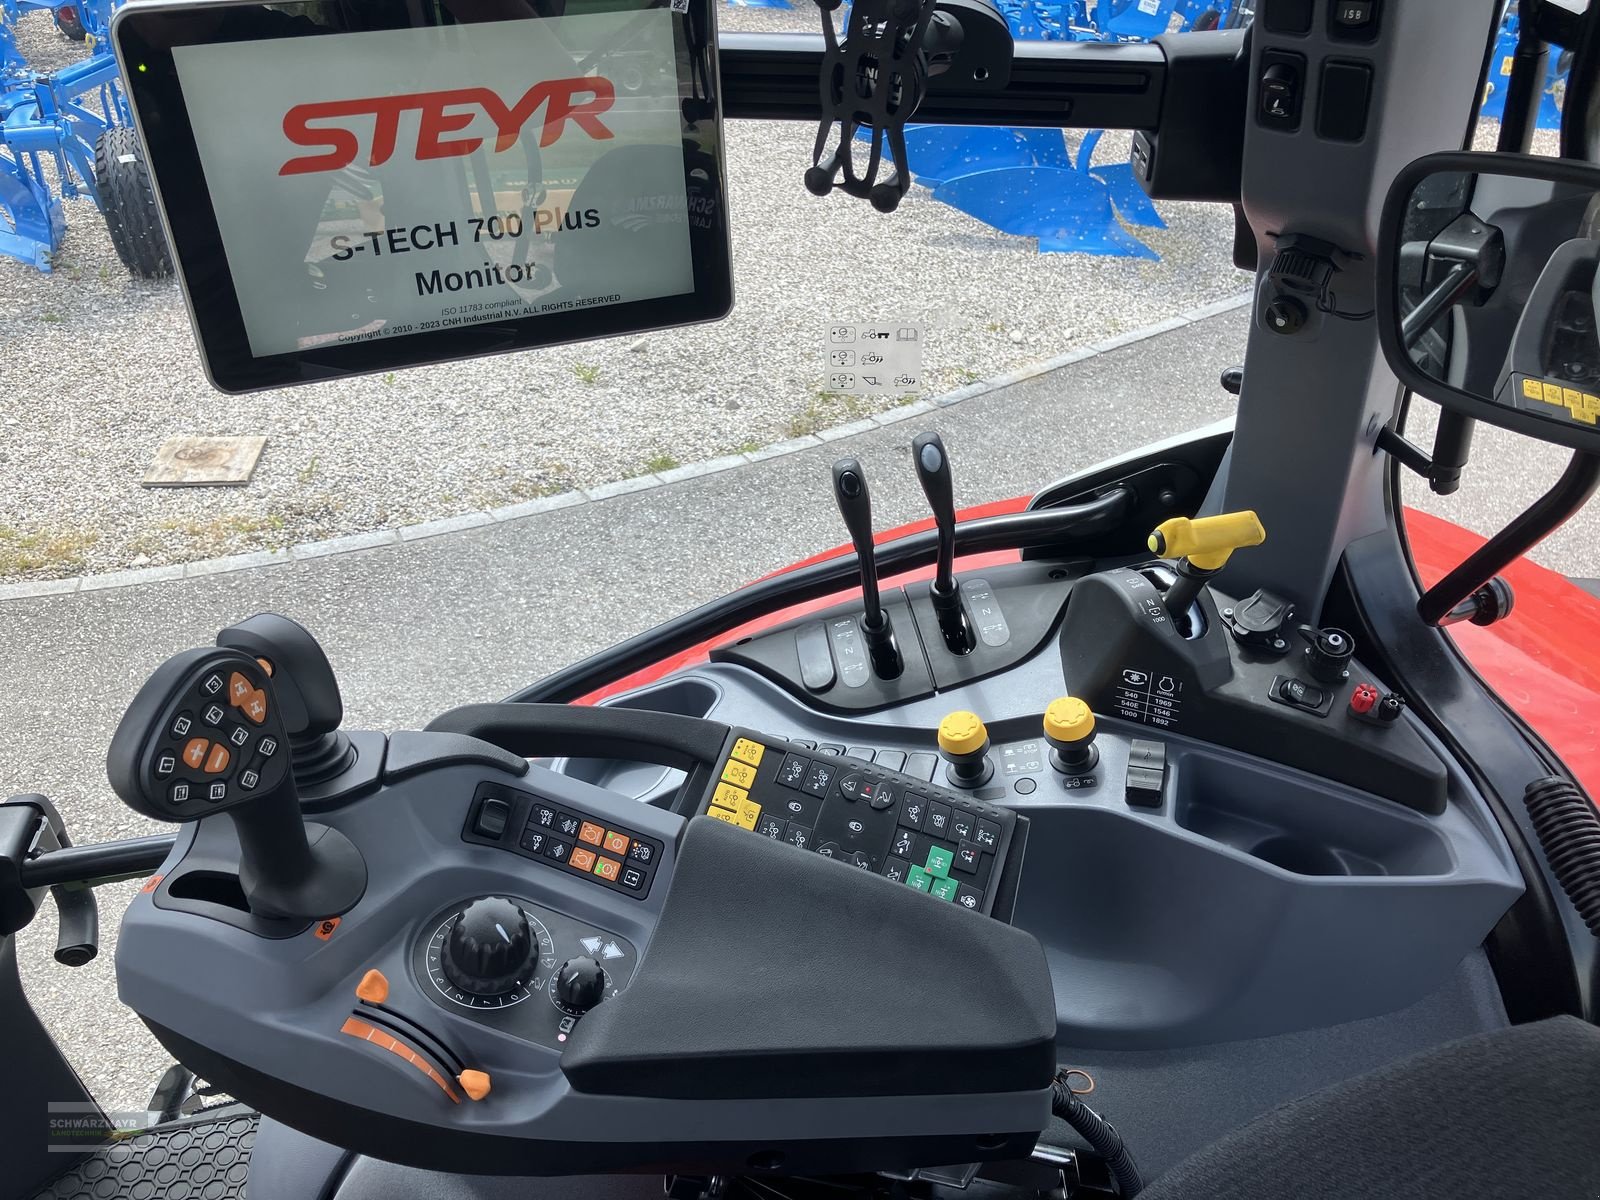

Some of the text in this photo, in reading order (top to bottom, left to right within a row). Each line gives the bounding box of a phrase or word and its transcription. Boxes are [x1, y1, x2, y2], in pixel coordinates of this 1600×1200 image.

[278, 76, 616, 176] STEYR
[330, 206, 600, 261] S-TECH 700 Plus
[414, 261, 536, 296] Monitor
[441, 297, 522, 316] ISO 11783 compliant
[338, 329, 381, 342] Copyright
[392, 324, 413, 334] 2010
[420, 320, 440, 331] 2023
[442, 316, 462, 326] CNH
[463, 310, 503, 323] Industrial
[504, 308, 522, 318] N.V.
[523, 305, 540, 315] ALL
[541, 301, 574, 312] RIGHTS
[575, 294, 621, 307] RESERVED
[210, 681, 219, 689] 3
[1124, 691, 1138, 699] 540
[1121, 700, 1139, 709] 540E
[1155, 698, 1172, 707] 1969
[1120, 709, 1138, 718] 1000
[1153, 707, 1171, 717] 1546
[1151, 716, 1169, 726] 1892
[178, 722, 187, 731] 2
[541, 937, 550, 946] 10
